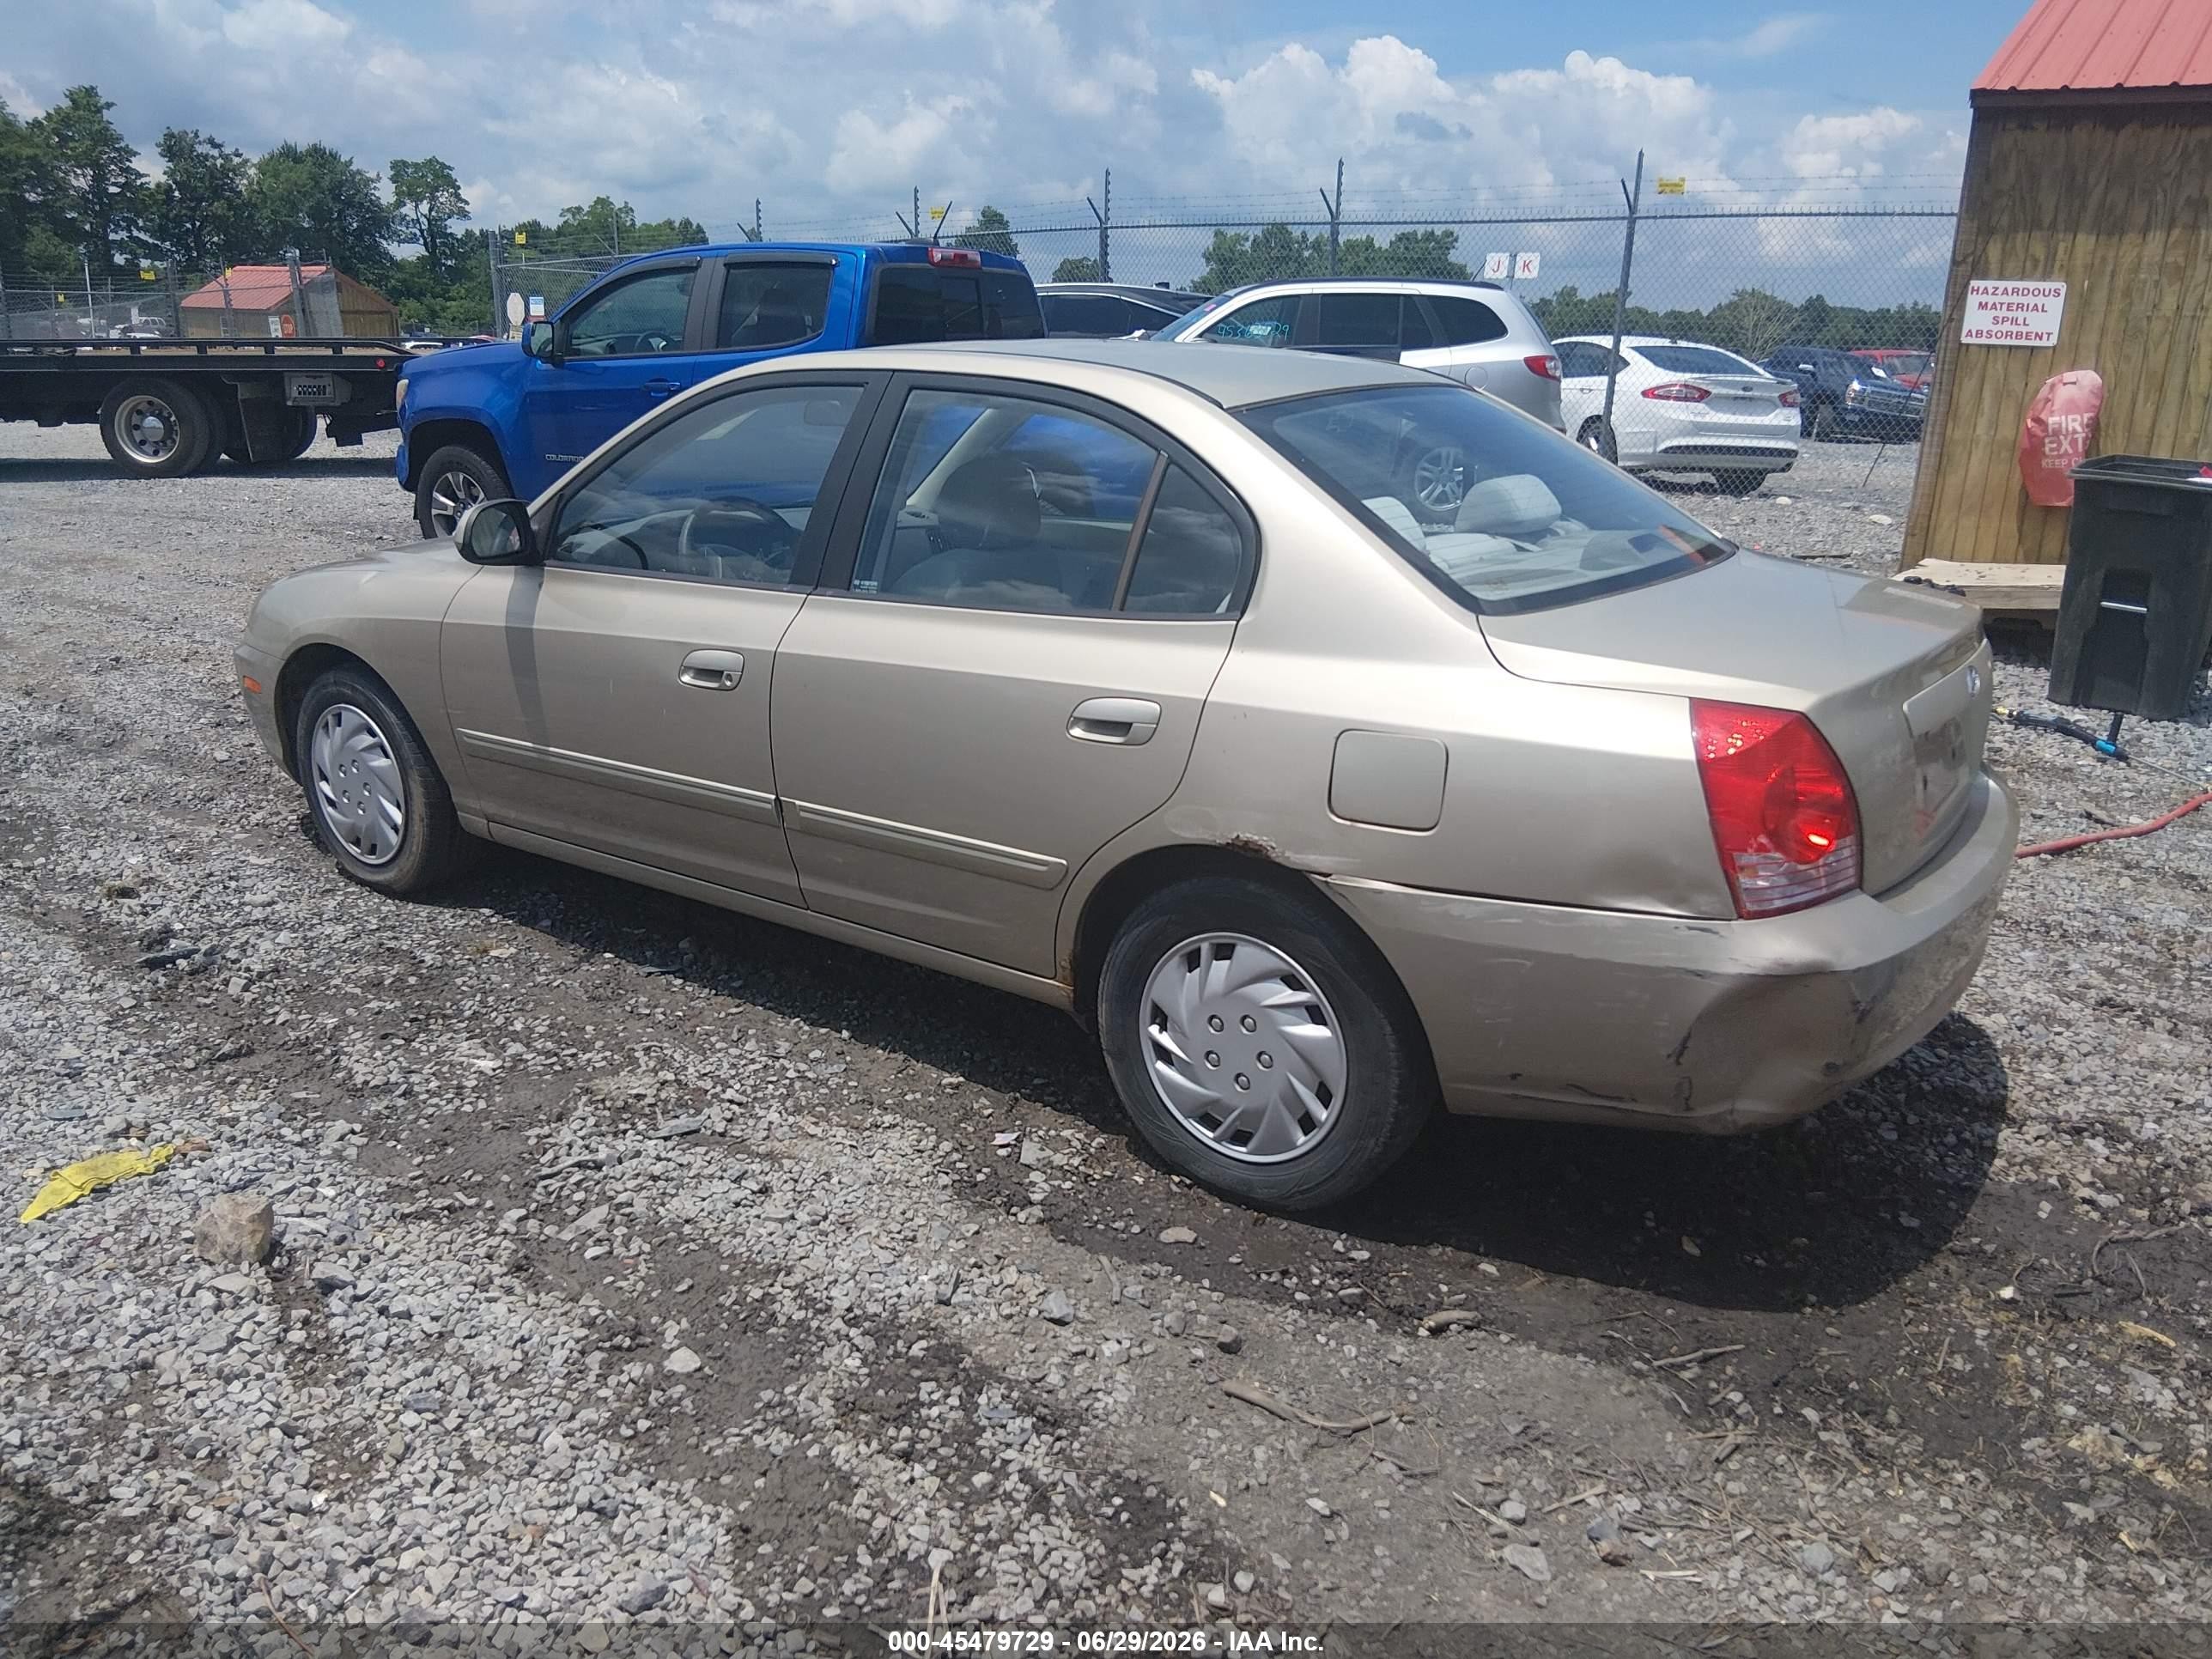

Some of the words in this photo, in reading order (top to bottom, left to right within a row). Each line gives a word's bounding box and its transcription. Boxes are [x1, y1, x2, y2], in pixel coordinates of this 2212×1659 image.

[1491, 259, 1501, 274] J
[1522, 260, 1533, 273] K
[1970, 285, 2062, 298] HAZARDOUS
[1978, 301, 2048, 313] MATERIAL
[1991, 315, 2030, 327] SPILL
[1964, 329, 2054, 342] ABSORBENT
[2041, 459, 2069, 468] KEEP
